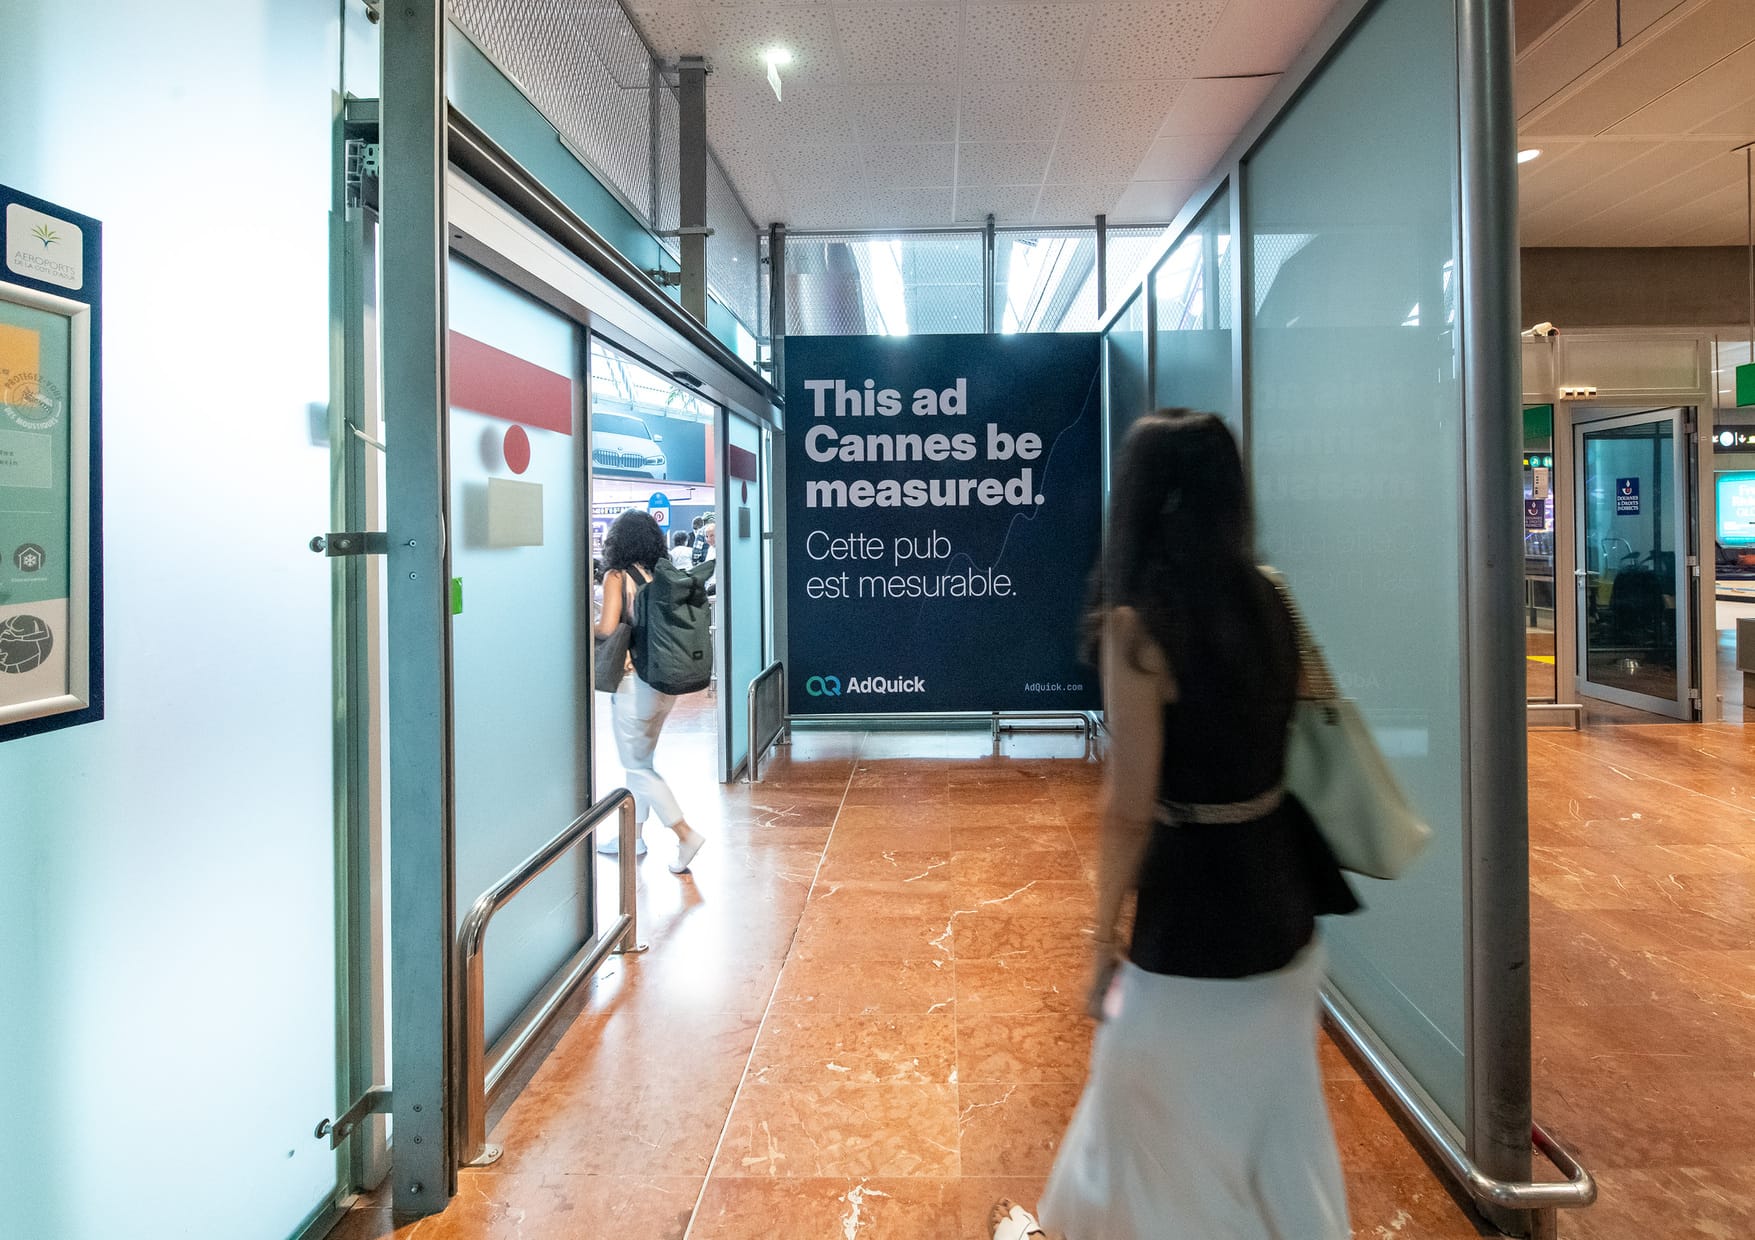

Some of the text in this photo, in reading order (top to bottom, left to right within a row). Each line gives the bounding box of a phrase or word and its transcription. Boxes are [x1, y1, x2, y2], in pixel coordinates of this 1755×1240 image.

[804, 377, 967, 417] This ad
[804, 423, 1042, 463] Cannes be
[806, 468, 1045, 508] measured.
[806, 529, 952, 567] Cette pub
[806, 567, 1017, 599] est mesurable.
[846, 676, 926, 694] AdQuick
[1024, 682, 1084, 693] AdQuick.com
